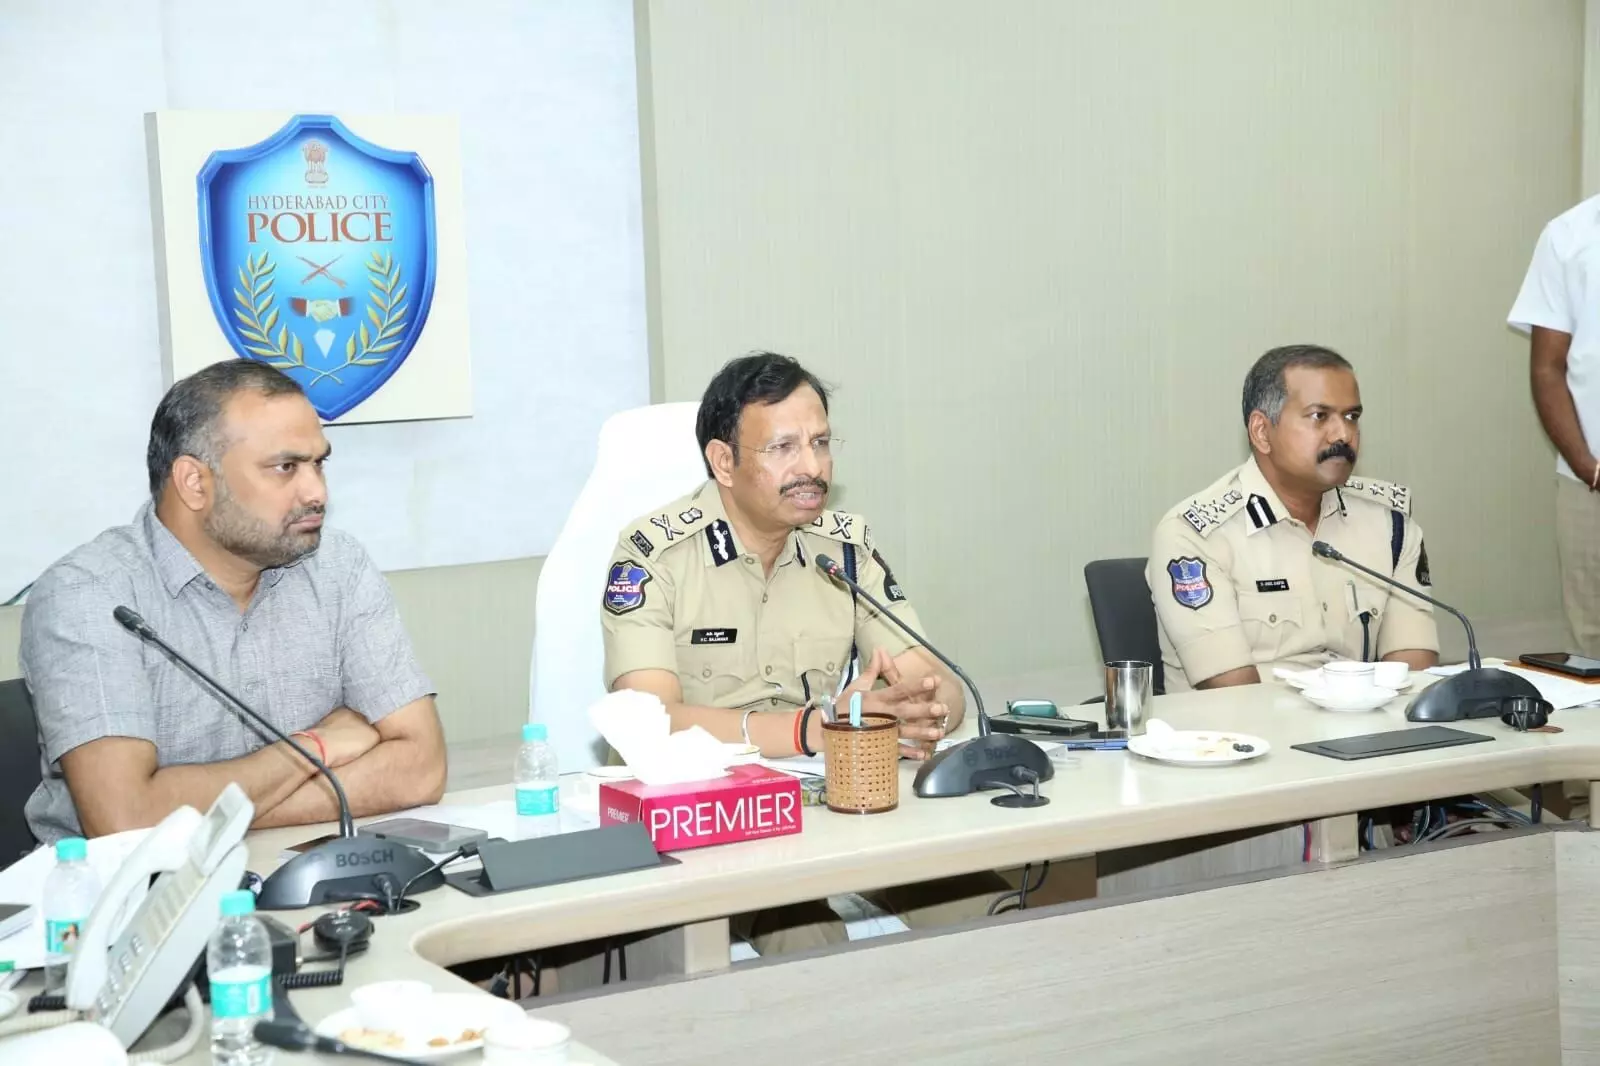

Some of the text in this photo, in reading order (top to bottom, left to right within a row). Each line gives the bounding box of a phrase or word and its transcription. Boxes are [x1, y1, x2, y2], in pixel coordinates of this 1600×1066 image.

[248, 194, 389, 210] HYDERABAD CITY
[247, 211, 393, 243] POLICE
[607, 585, 640, 593] POLICE
[607, 806, 630, 823] PREMIER
[651, 792, 796, 842] PREMIER
[335, 848, 395, 868] BOSCH
